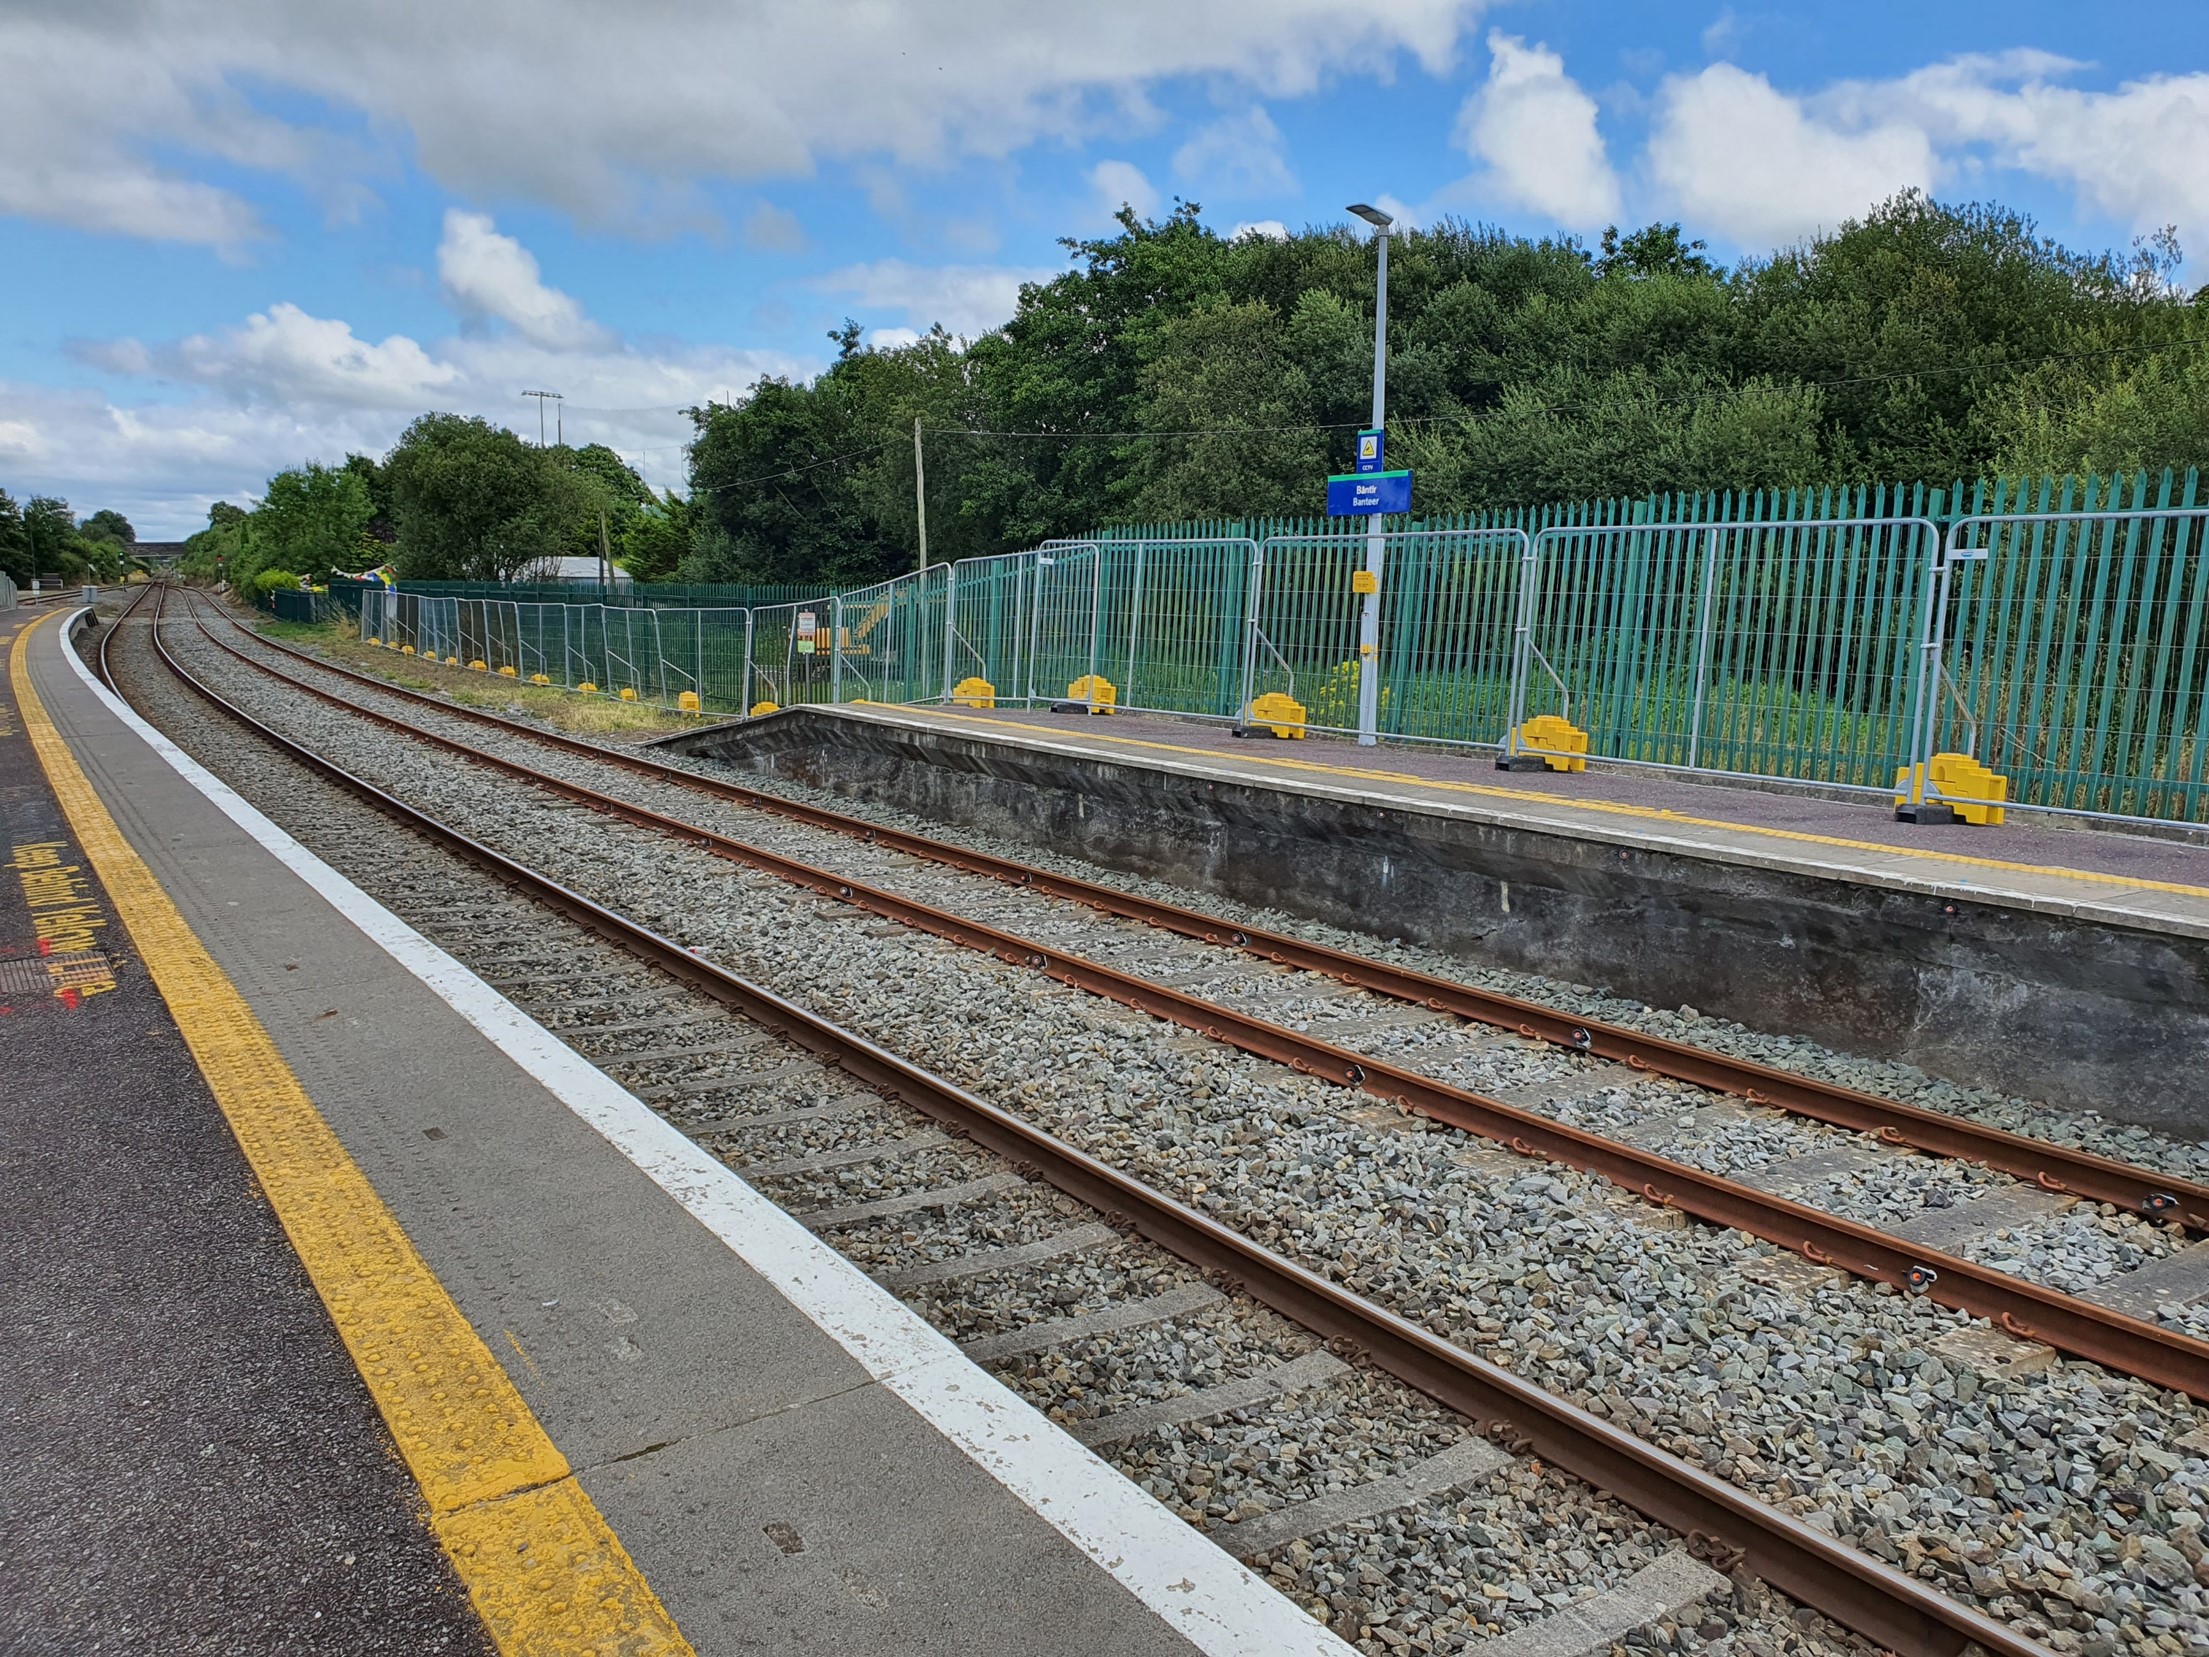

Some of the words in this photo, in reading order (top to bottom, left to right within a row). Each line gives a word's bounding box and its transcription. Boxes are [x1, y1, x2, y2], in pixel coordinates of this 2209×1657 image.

[1352, 496, 1380, 507] Banteer
[4, 840, 69, 869] Keep
[20, 865, 95, 907] Behind
[32, 904, 108, 955] Yellow
